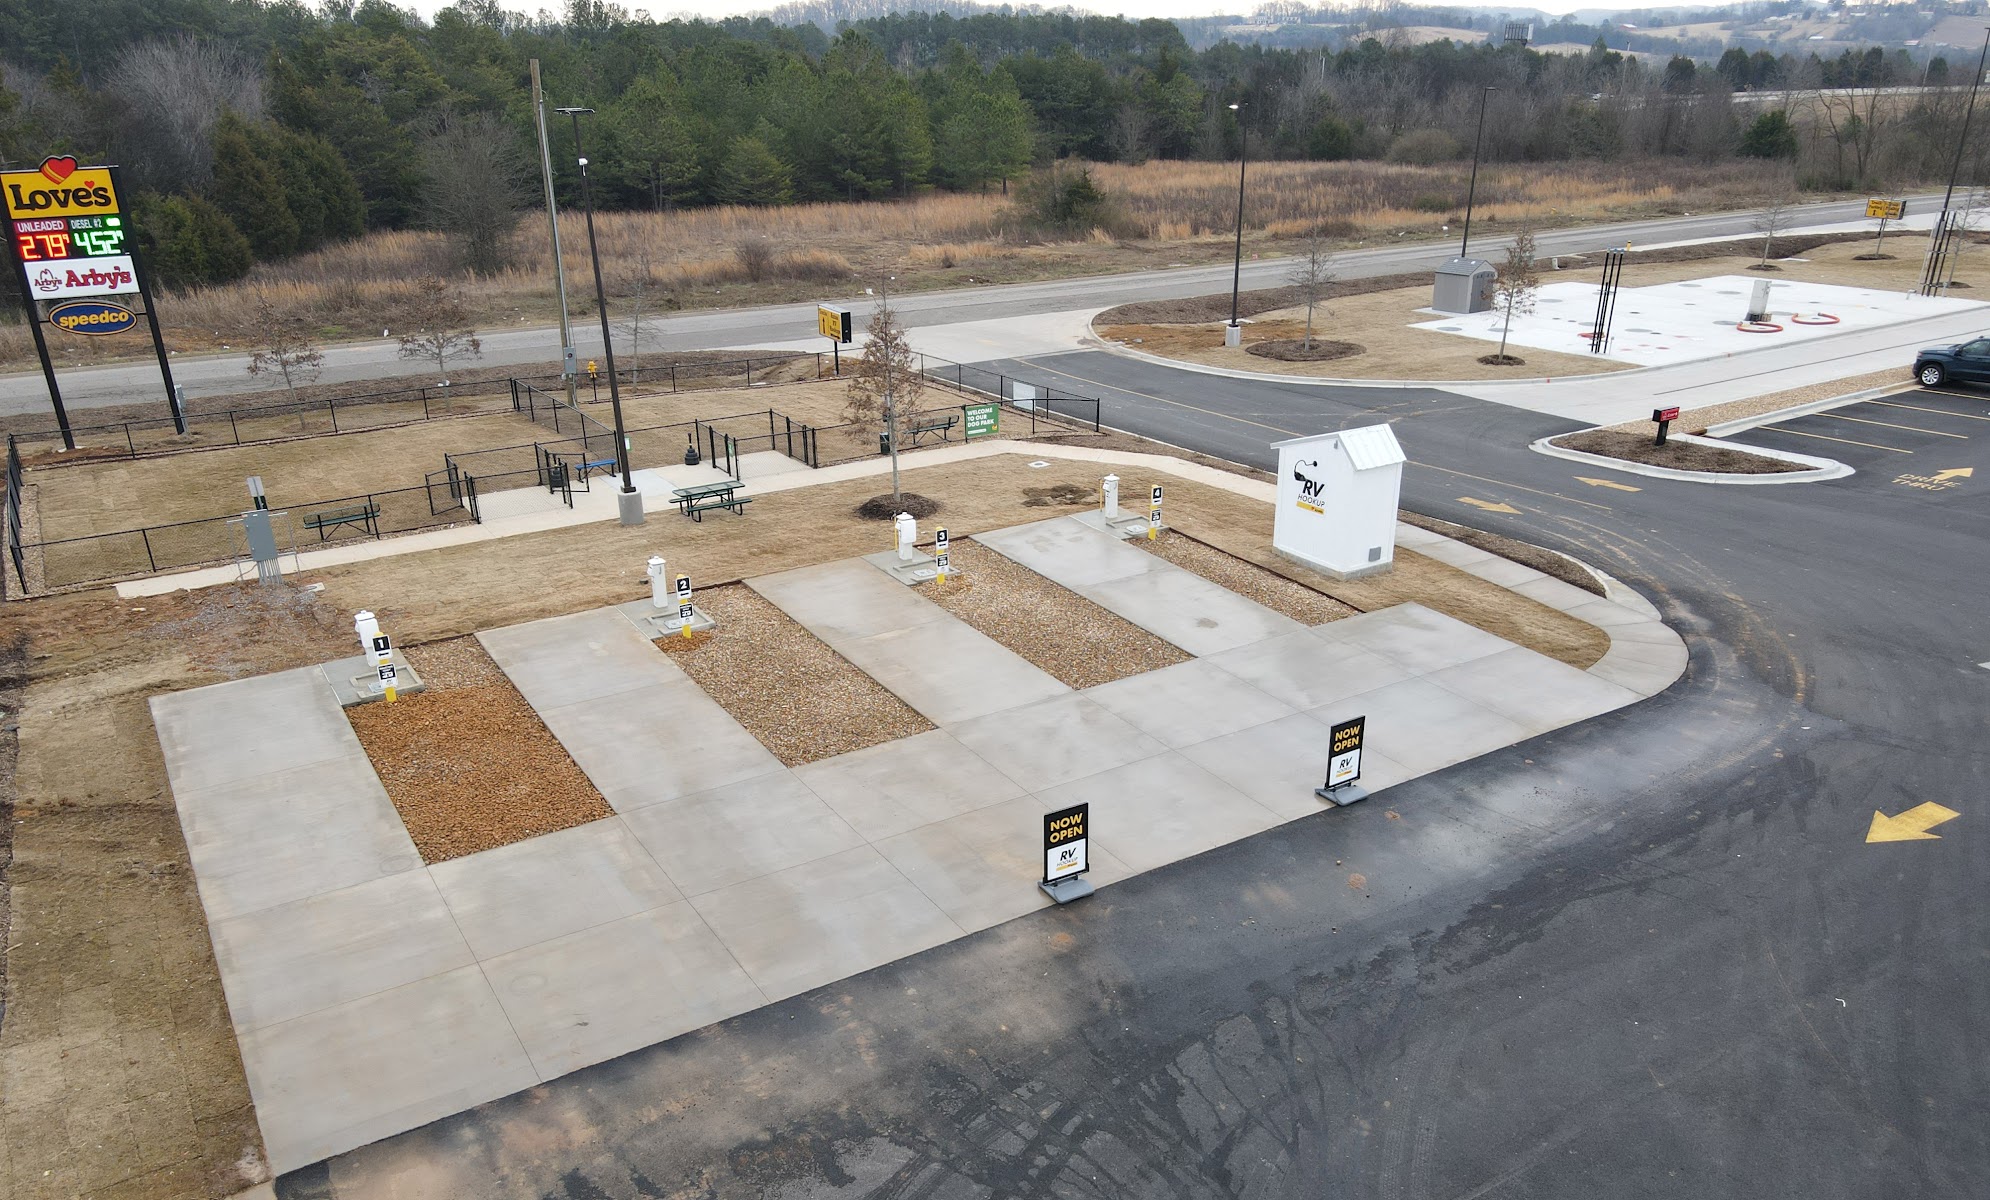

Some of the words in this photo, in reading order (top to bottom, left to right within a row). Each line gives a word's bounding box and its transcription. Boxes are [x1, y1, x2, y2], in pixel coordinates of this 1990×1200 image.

[17, 220, 64, 233] UNLEADED
[71, 219, 93, 230] DIESEL
[34, 276, 62, 287] Arby's
[66, 266, 132, 289] Arby's
[59, 310, 129, 329] speedco
[967, 407, 993, 416] WELCOME
[1154, 488, 1160, 497] 4
[1302, 479, 1325, 497] RV
[1298, 494, 1325, 508] HOOKUP
[938, 531, 946, 541] 3
[680, 580, 688, 590] 2
[377, 639, 385, 649] 1
[1335, 725, 1360, 742] NOW
[1333, 736, 1360, 752] OPEN
[1339, 756, 1353, 769] RV
[1050, 813, 1083, 832] NOW
[1049, 825, 1083, 843] OPEN
[1060, 847, 1077, 861] RV
